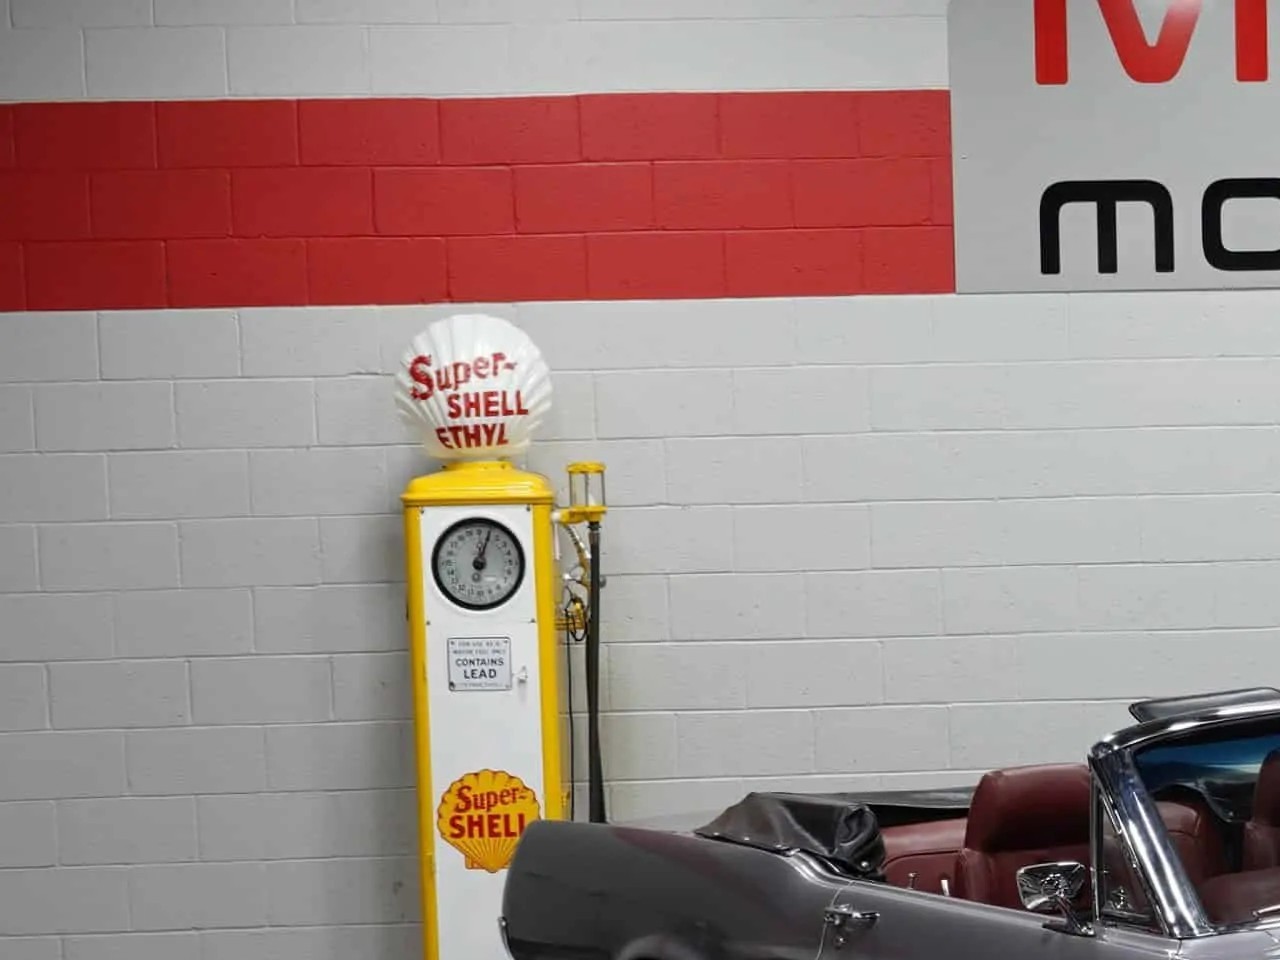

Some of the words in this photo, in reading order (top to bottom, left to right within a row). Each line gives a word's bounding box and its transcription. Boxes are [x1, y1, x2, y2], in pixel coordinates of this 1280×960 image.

[448, 390, 529, 419] SHELL
[436, 423, 509, 449] ETHYL
[455, 657, 504, 667] CONTAINS
[463, 668, 497, 679] LEAD
